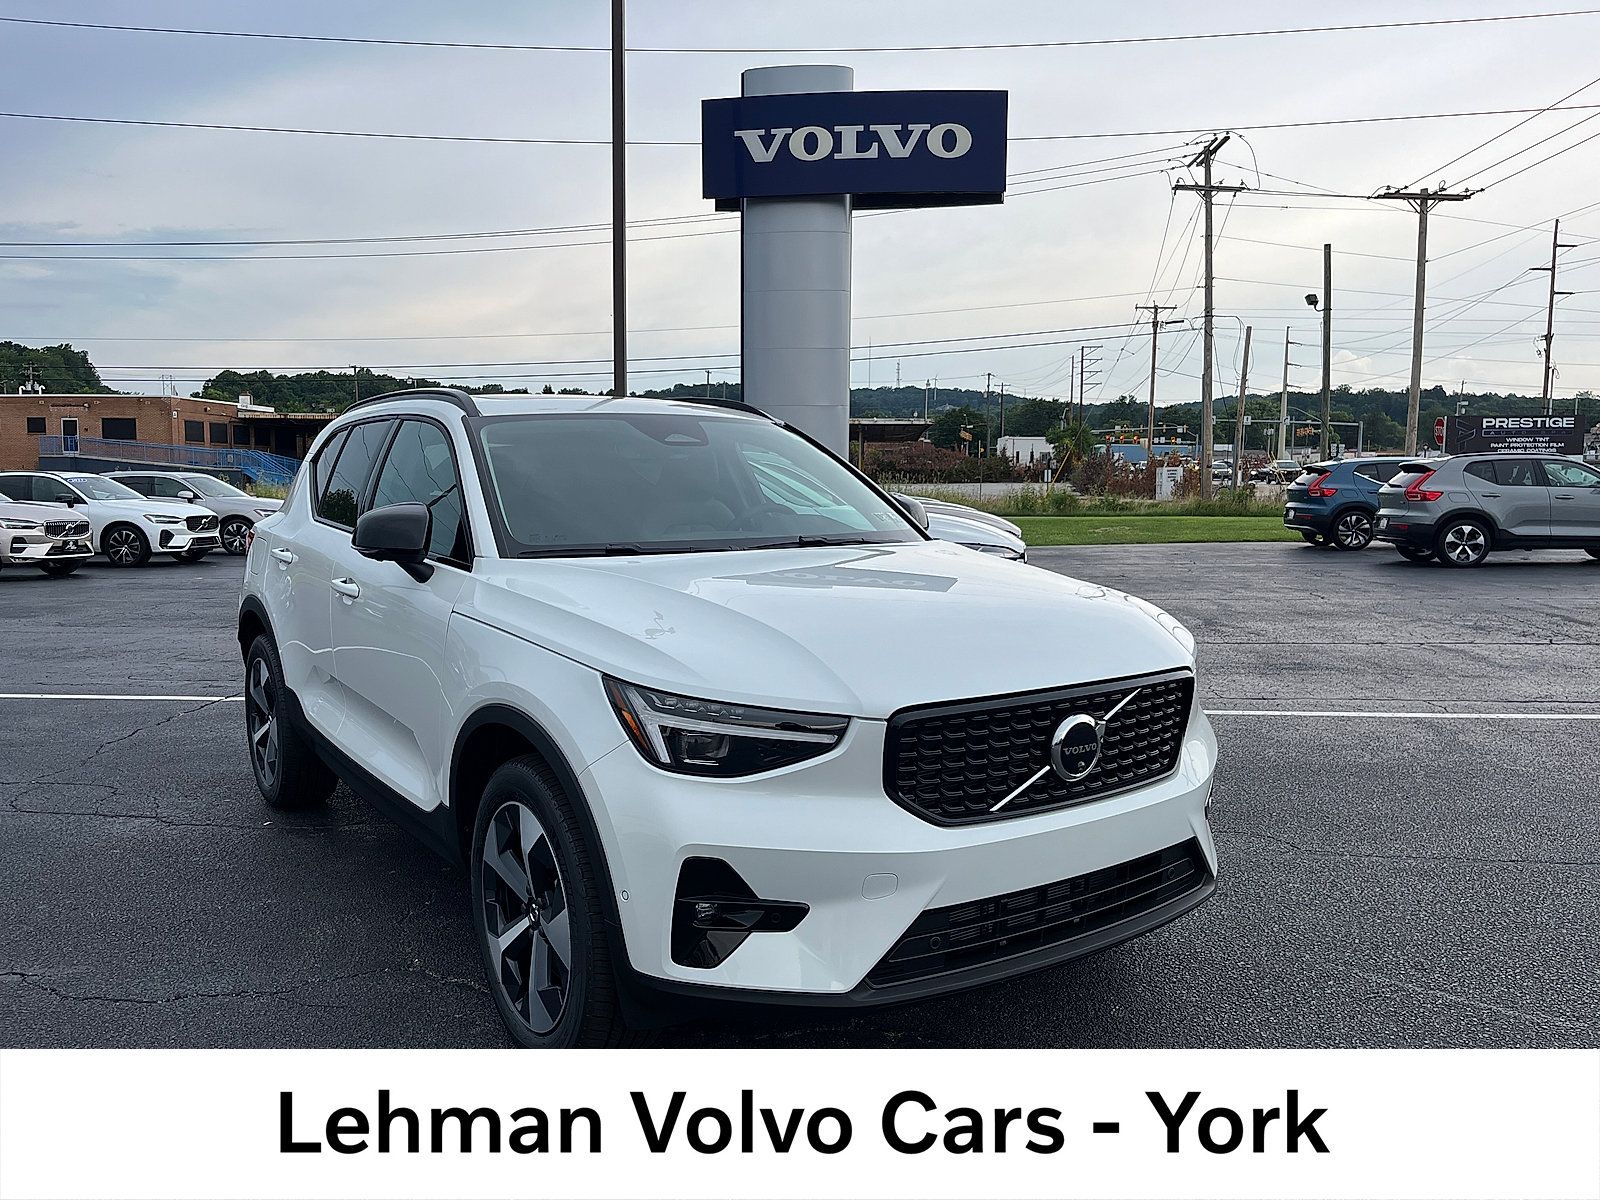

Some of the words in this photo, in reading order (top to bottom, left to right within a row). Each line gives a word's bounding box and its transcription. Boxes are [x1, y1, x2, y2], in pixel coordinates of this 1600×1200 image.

[734, 123, 973, 163] VOLVO
[1482, 417, 1575, 429] PRESTIGE
[1063, 743, 1097, 755] VOLVO
